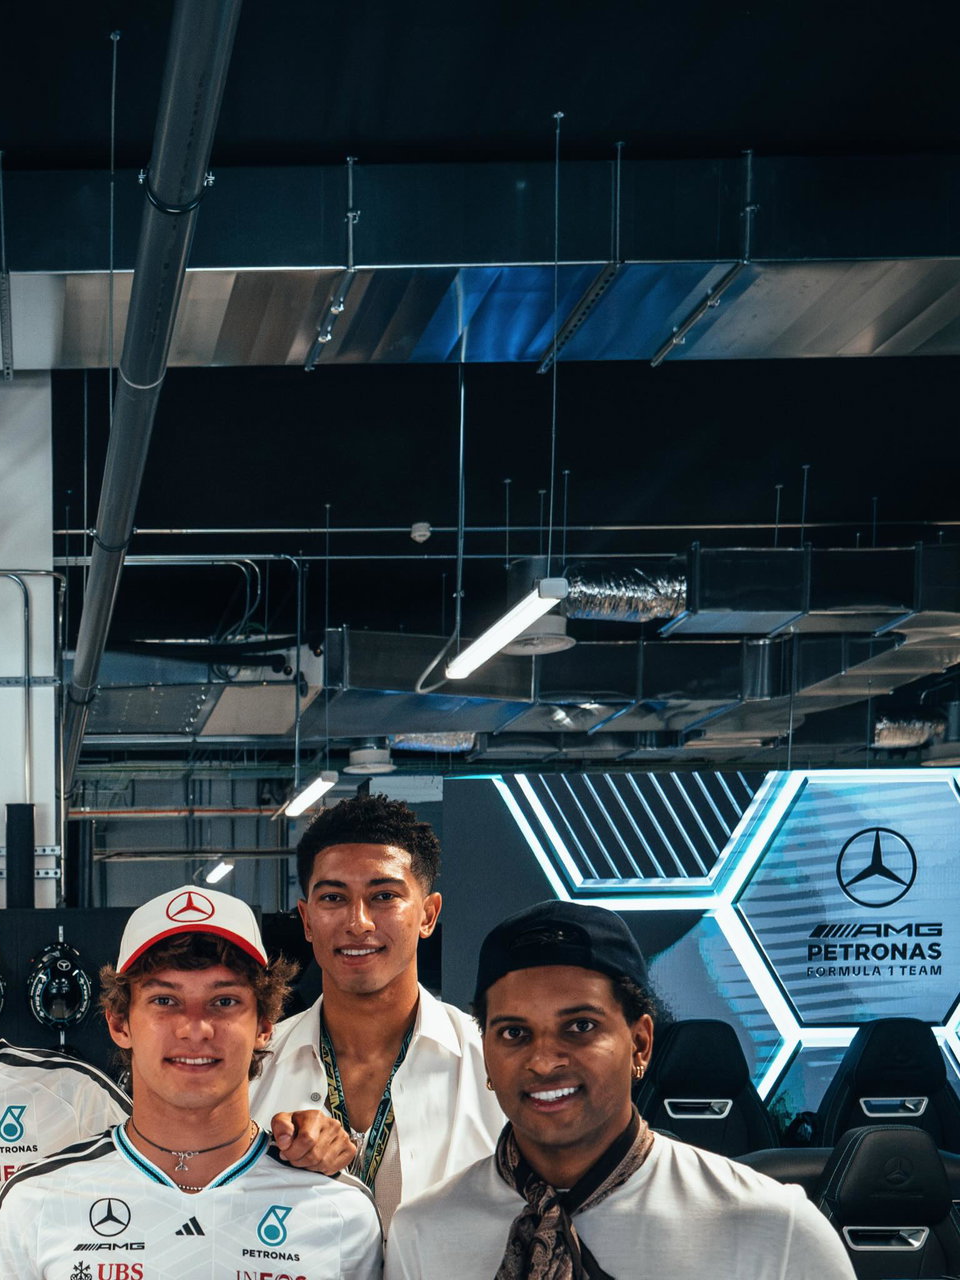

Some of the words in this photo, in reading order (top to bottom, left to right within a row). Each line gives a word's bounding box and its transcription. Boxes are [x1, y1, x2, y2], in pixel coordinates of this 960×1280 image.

[851, 923, 943, 938] AMG
[807, 943, 942, 961] PETRONAS
[806, 966, 881, 977] FORMULA
[888, 966, 894, 976] 1
[899, 965, 942, 976] TEAM
[97, 1242, 145, 1252] AMG
[242, 1248, 301, 1262] PETRONAS
